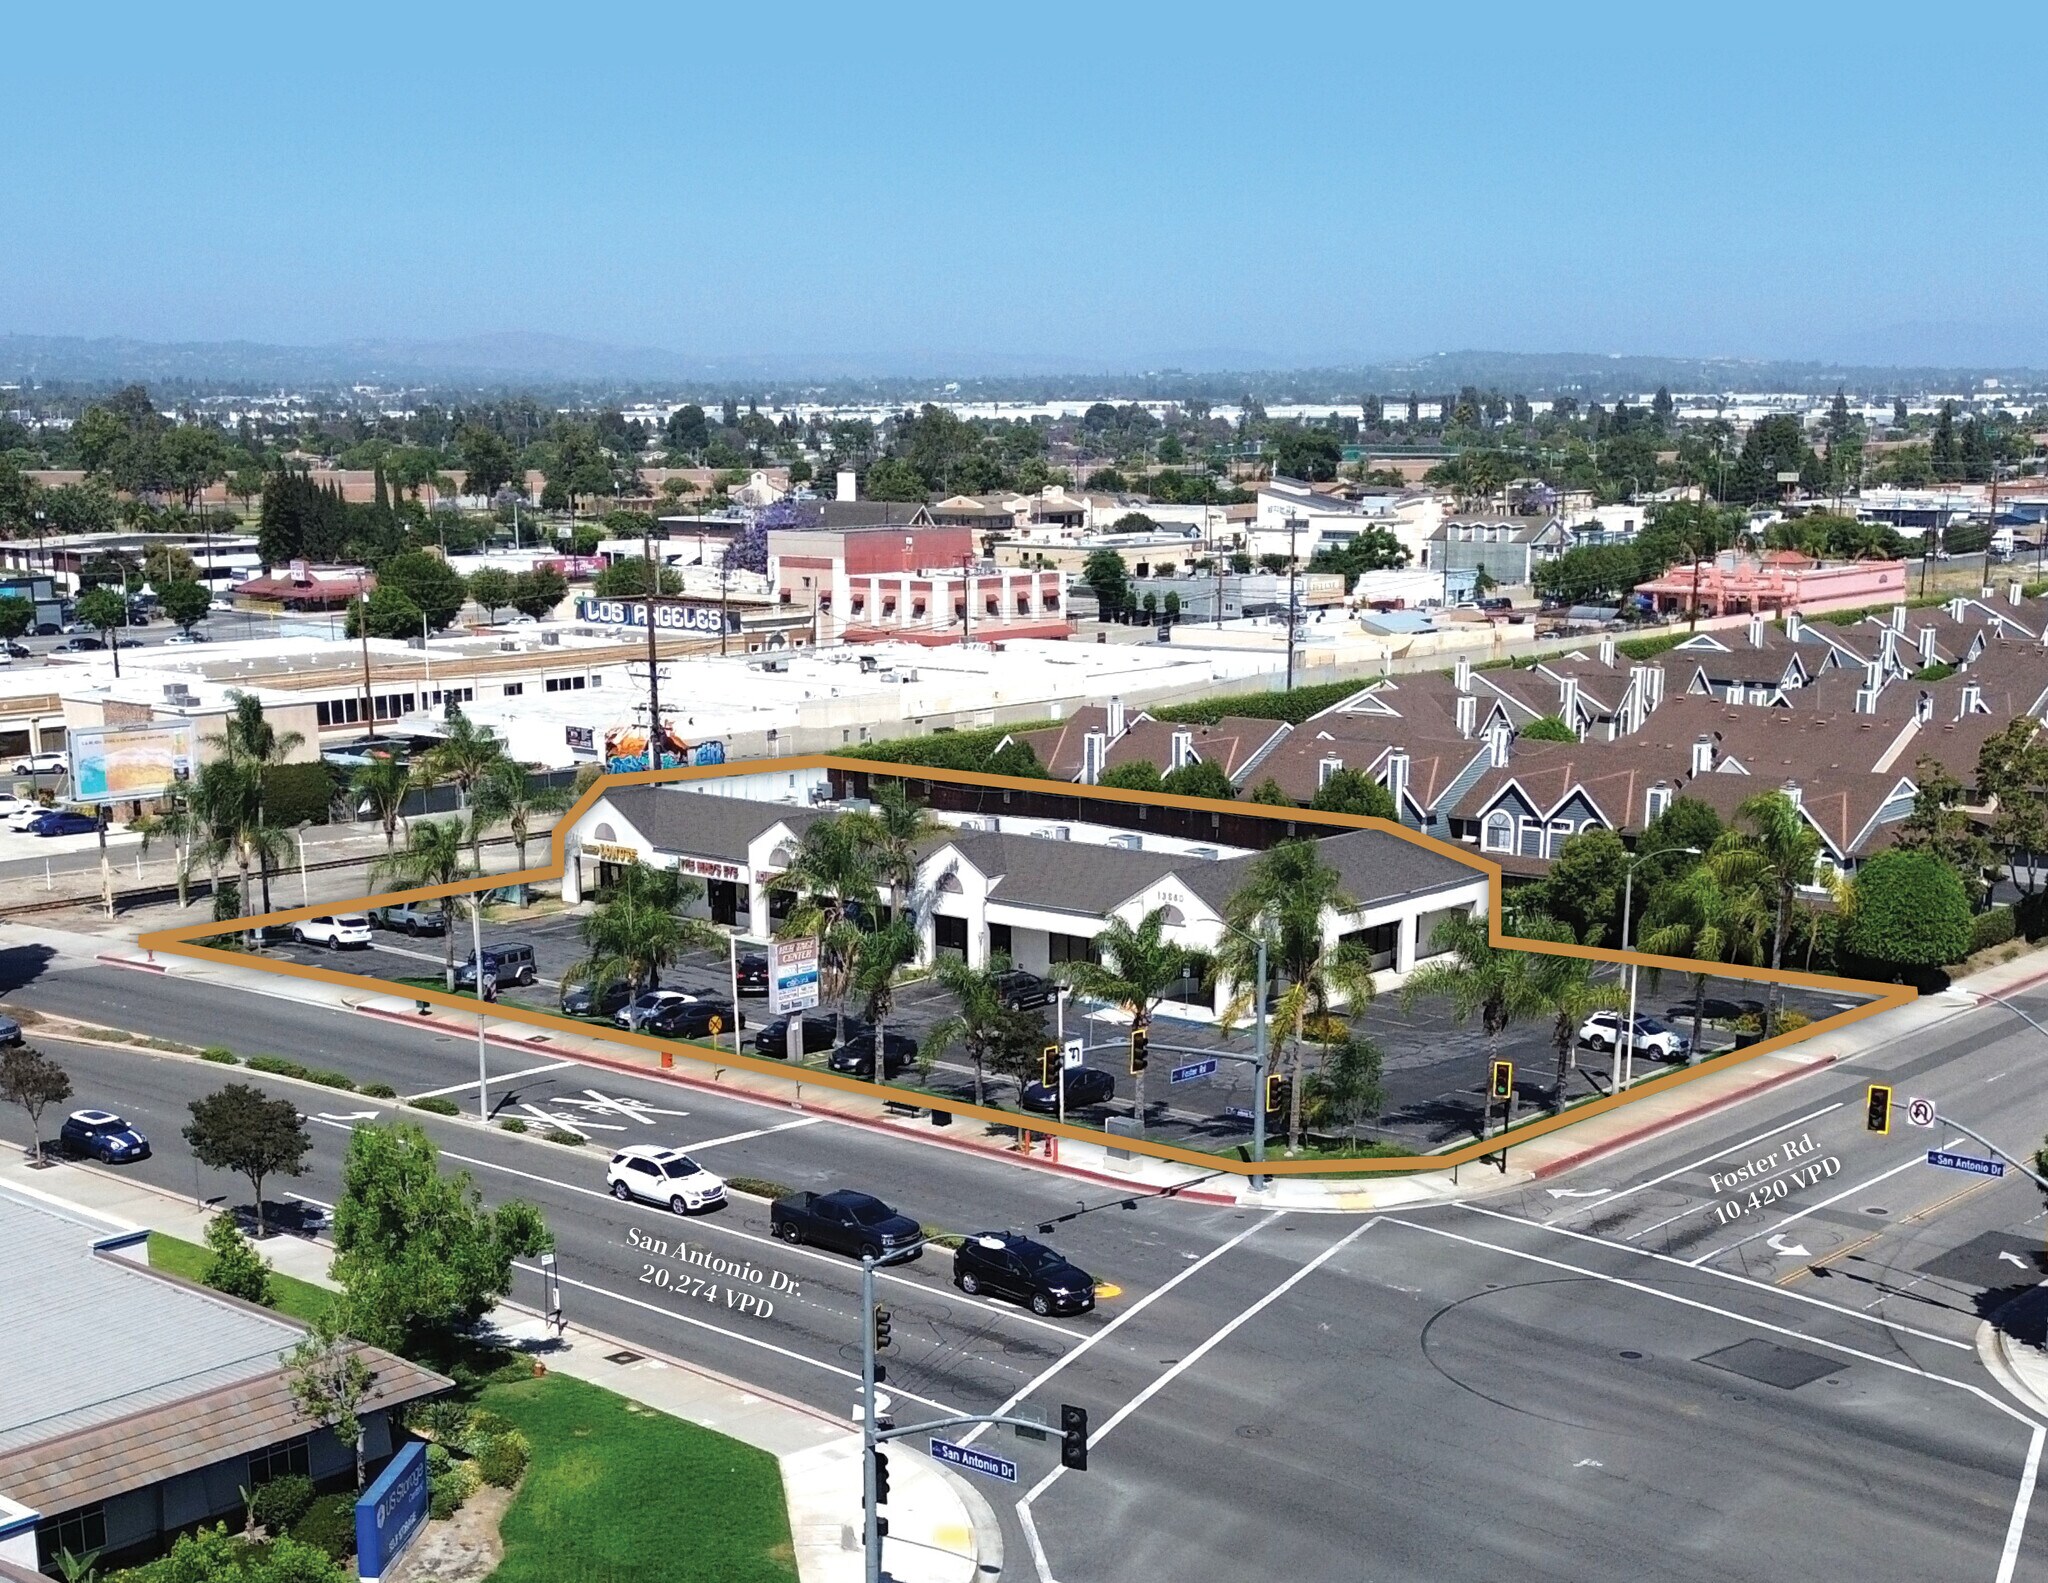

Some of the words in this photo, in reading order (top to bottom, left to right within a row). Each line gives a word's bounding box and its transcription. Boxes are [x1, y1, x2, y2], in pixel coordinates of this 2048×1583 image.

[587, 601, 625, 622] LOS
[633, 604, 722, 631] ANGELES
[779, 940, 814, 955] HERTAGE
[782, 950, 813, 963] CENTER
[1937, 1154, 1953, 1166] San
[1956, 1158, 1989, 1173] Antonio
[1991, 1165, 2002, 1175] Dr
[941, 1446, 960, 1462] San
[962, 1452, 998, 1474] Antonio
[1001, 1463, 1014, 1478] Dr
[385, 1491, 397, 1516] US
[396, 1462, 424, 1503] Storage
